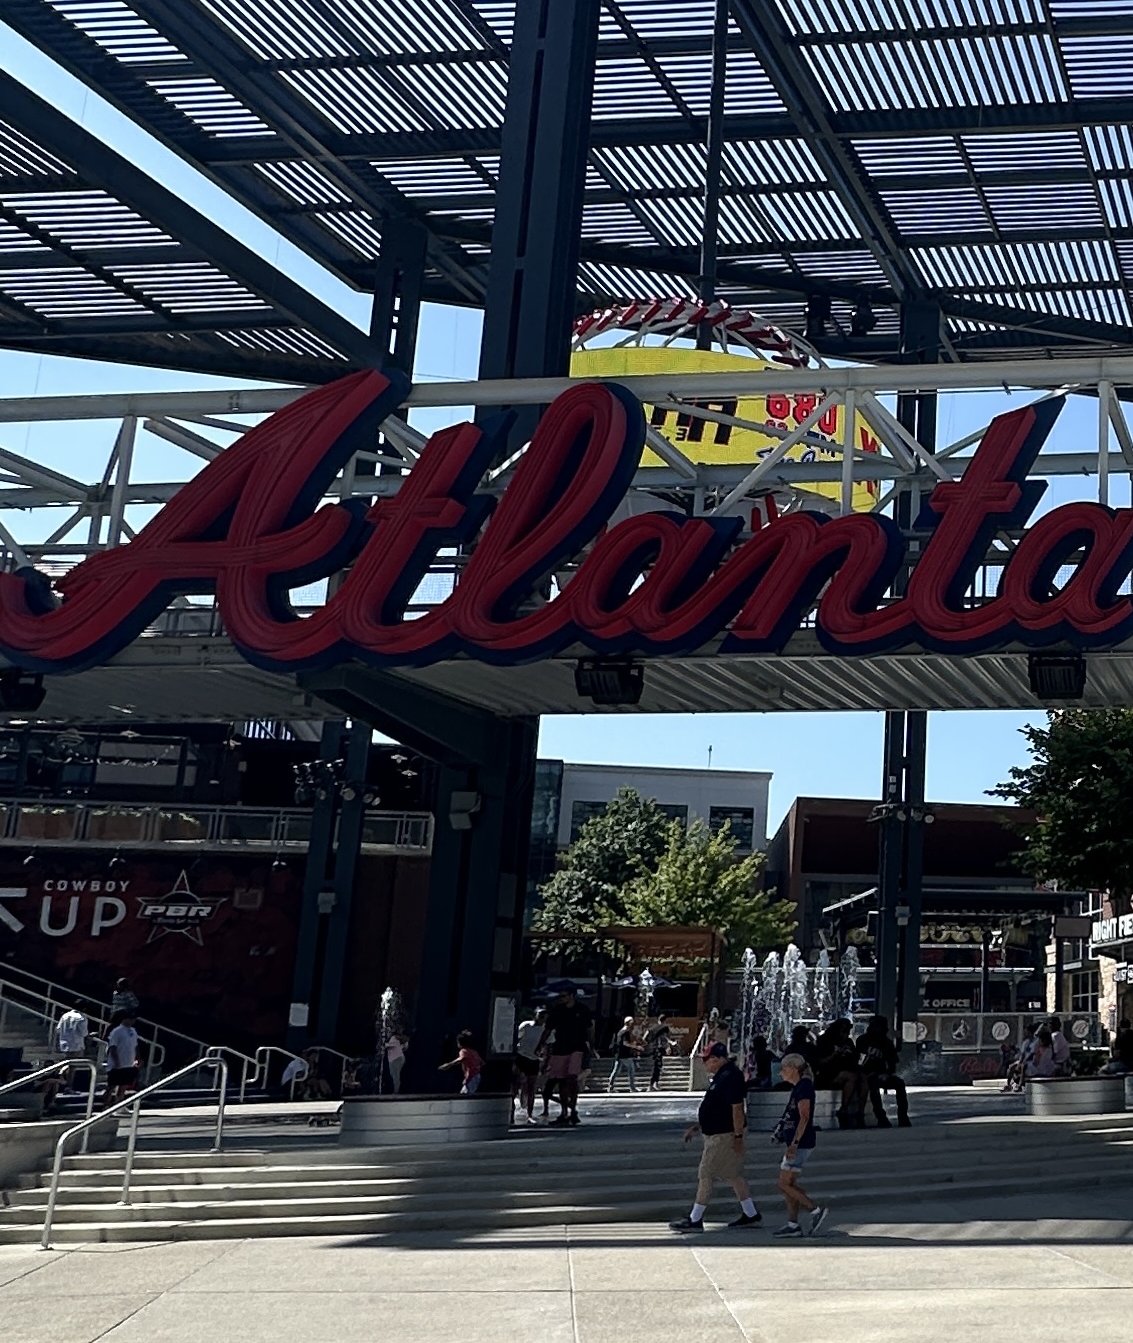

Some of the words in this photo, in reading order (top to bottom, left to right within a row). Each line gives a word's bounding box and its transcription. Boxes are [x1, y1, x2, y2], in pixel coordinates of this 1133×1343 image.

[44, 880, 131, 892] COWBOY
[39, 896, 127, 936] UP
[143, 905, 212, 917] PBR
[1092, 919, 1118, 940] RIGHT
[932, 998, 970, 1008] OFFICE
